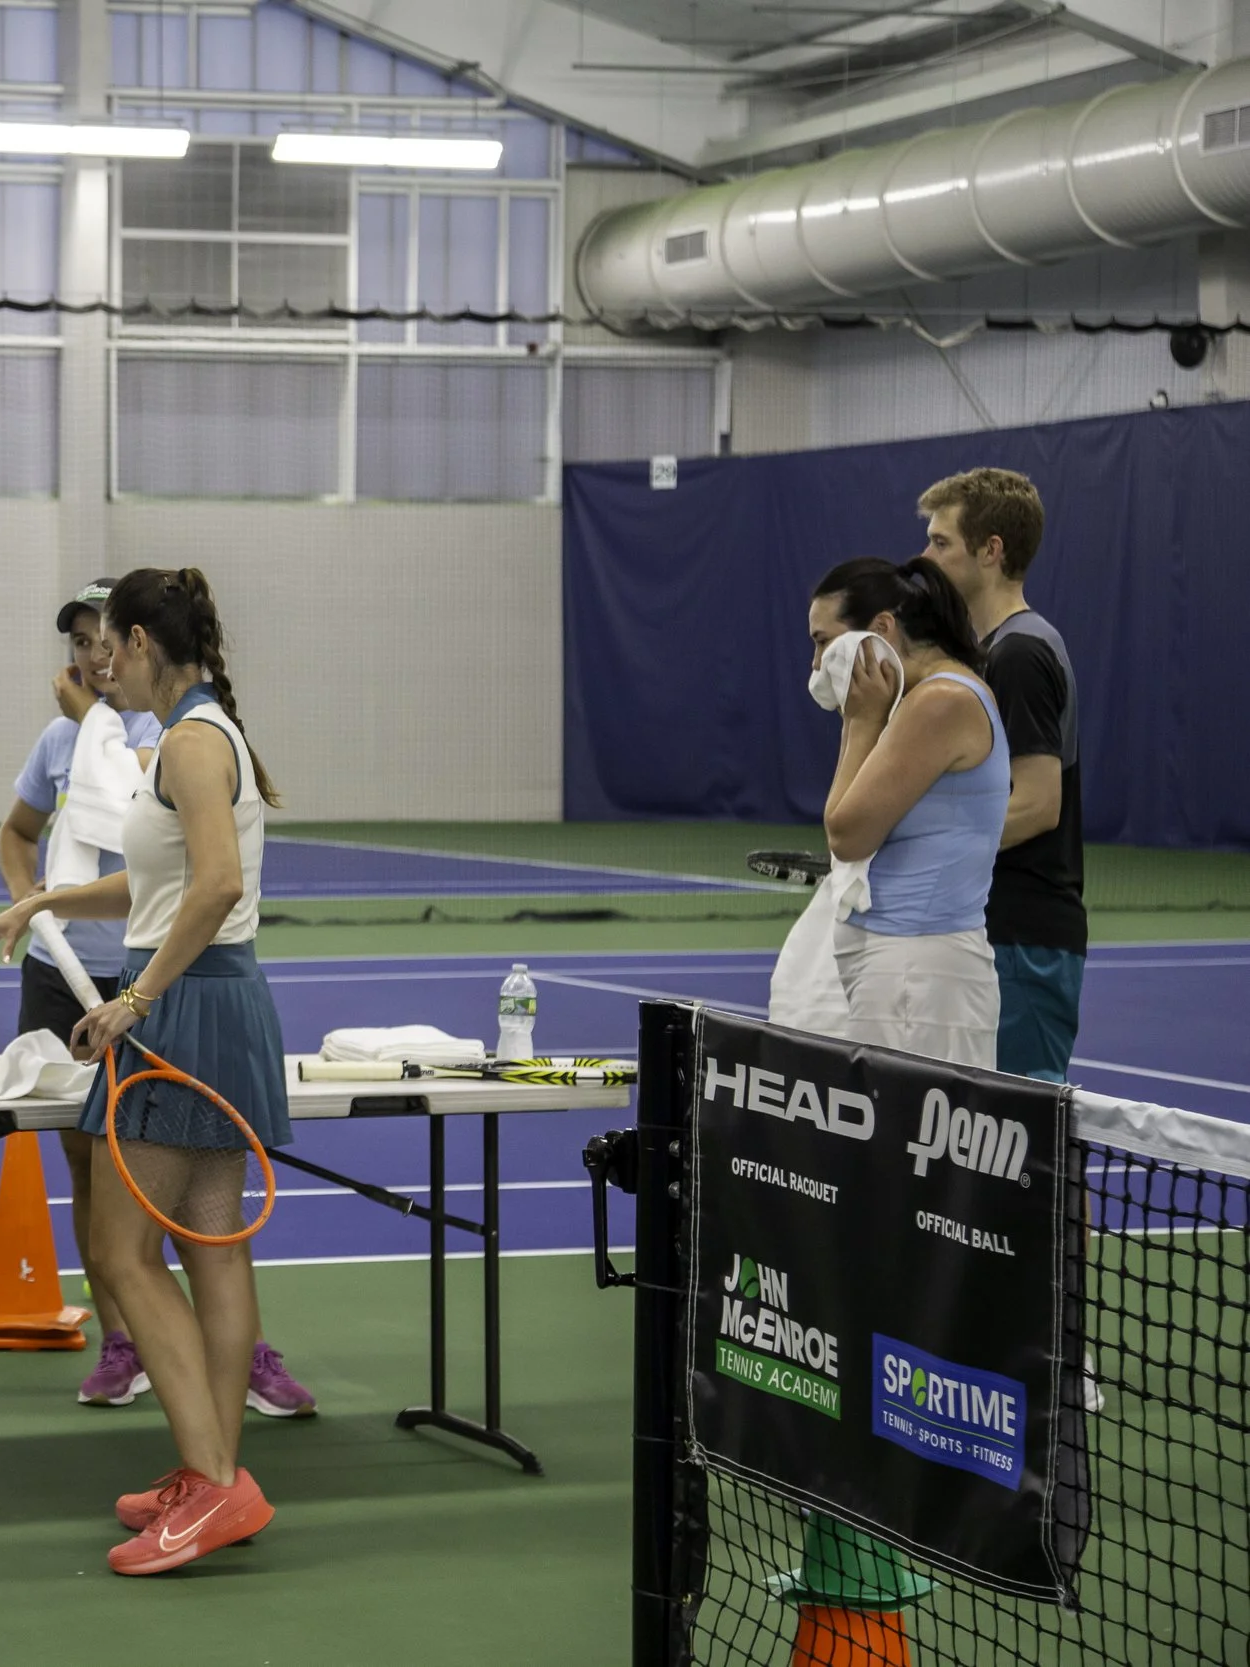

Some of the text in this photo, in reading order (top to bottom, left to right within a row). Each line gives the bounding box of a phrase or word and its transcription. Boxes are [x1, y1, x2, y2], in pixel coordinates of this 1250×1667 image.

[704, 1057, 876, 1141] HEAD
[731, 1156, 839, 1204] OFFICIAL RACQUET
[916, 1209, 1016, 1257] OFFICIAL BALL
[724, 1253, 789, 1313] JOHN
[720, 1295, 839, 1379] McENROE
[719, 1347, 838, 1411] TENNIS ACADEMY
[883, 1353, 1016, 1437] SPORTIME
[883, 1410, 1013, 1472] TENNIS SPORTS FITNESS
